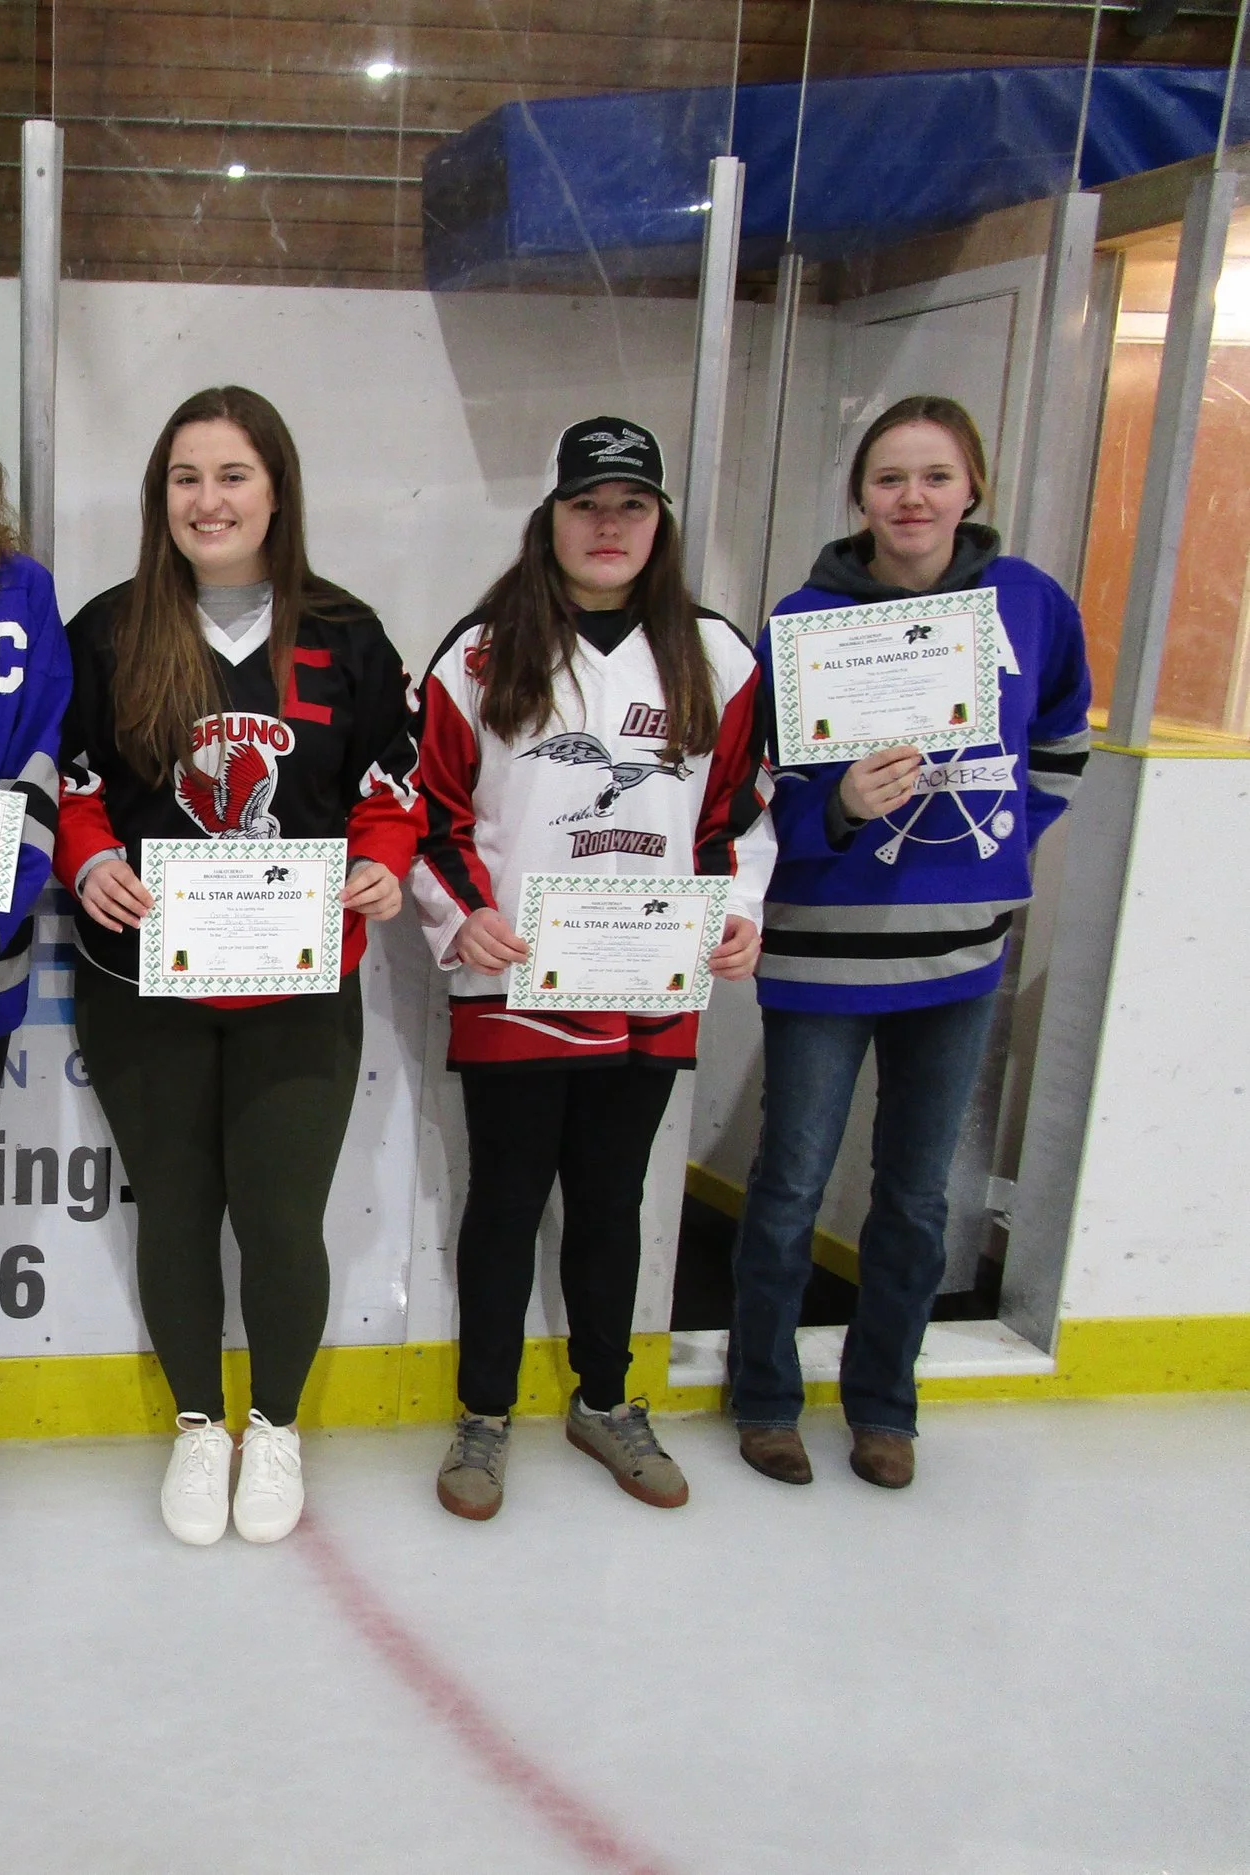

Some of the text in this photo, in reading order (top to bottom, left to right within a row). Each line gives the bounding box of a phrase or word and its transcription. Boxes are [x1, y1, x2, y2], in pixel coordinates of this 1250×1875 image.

[823, 646, 949, 671] ALL STAR AWARD 2020
[619, 702, 669, 740] DEB
[190, 716, 290, 752] BRUNO
[913, 766, 1009, 790] ACKERS
[188, 890, 303, 901] ALL STAR AWARD 2020
[563, 920, 680, 931] ALL STAR AWARD 2020
